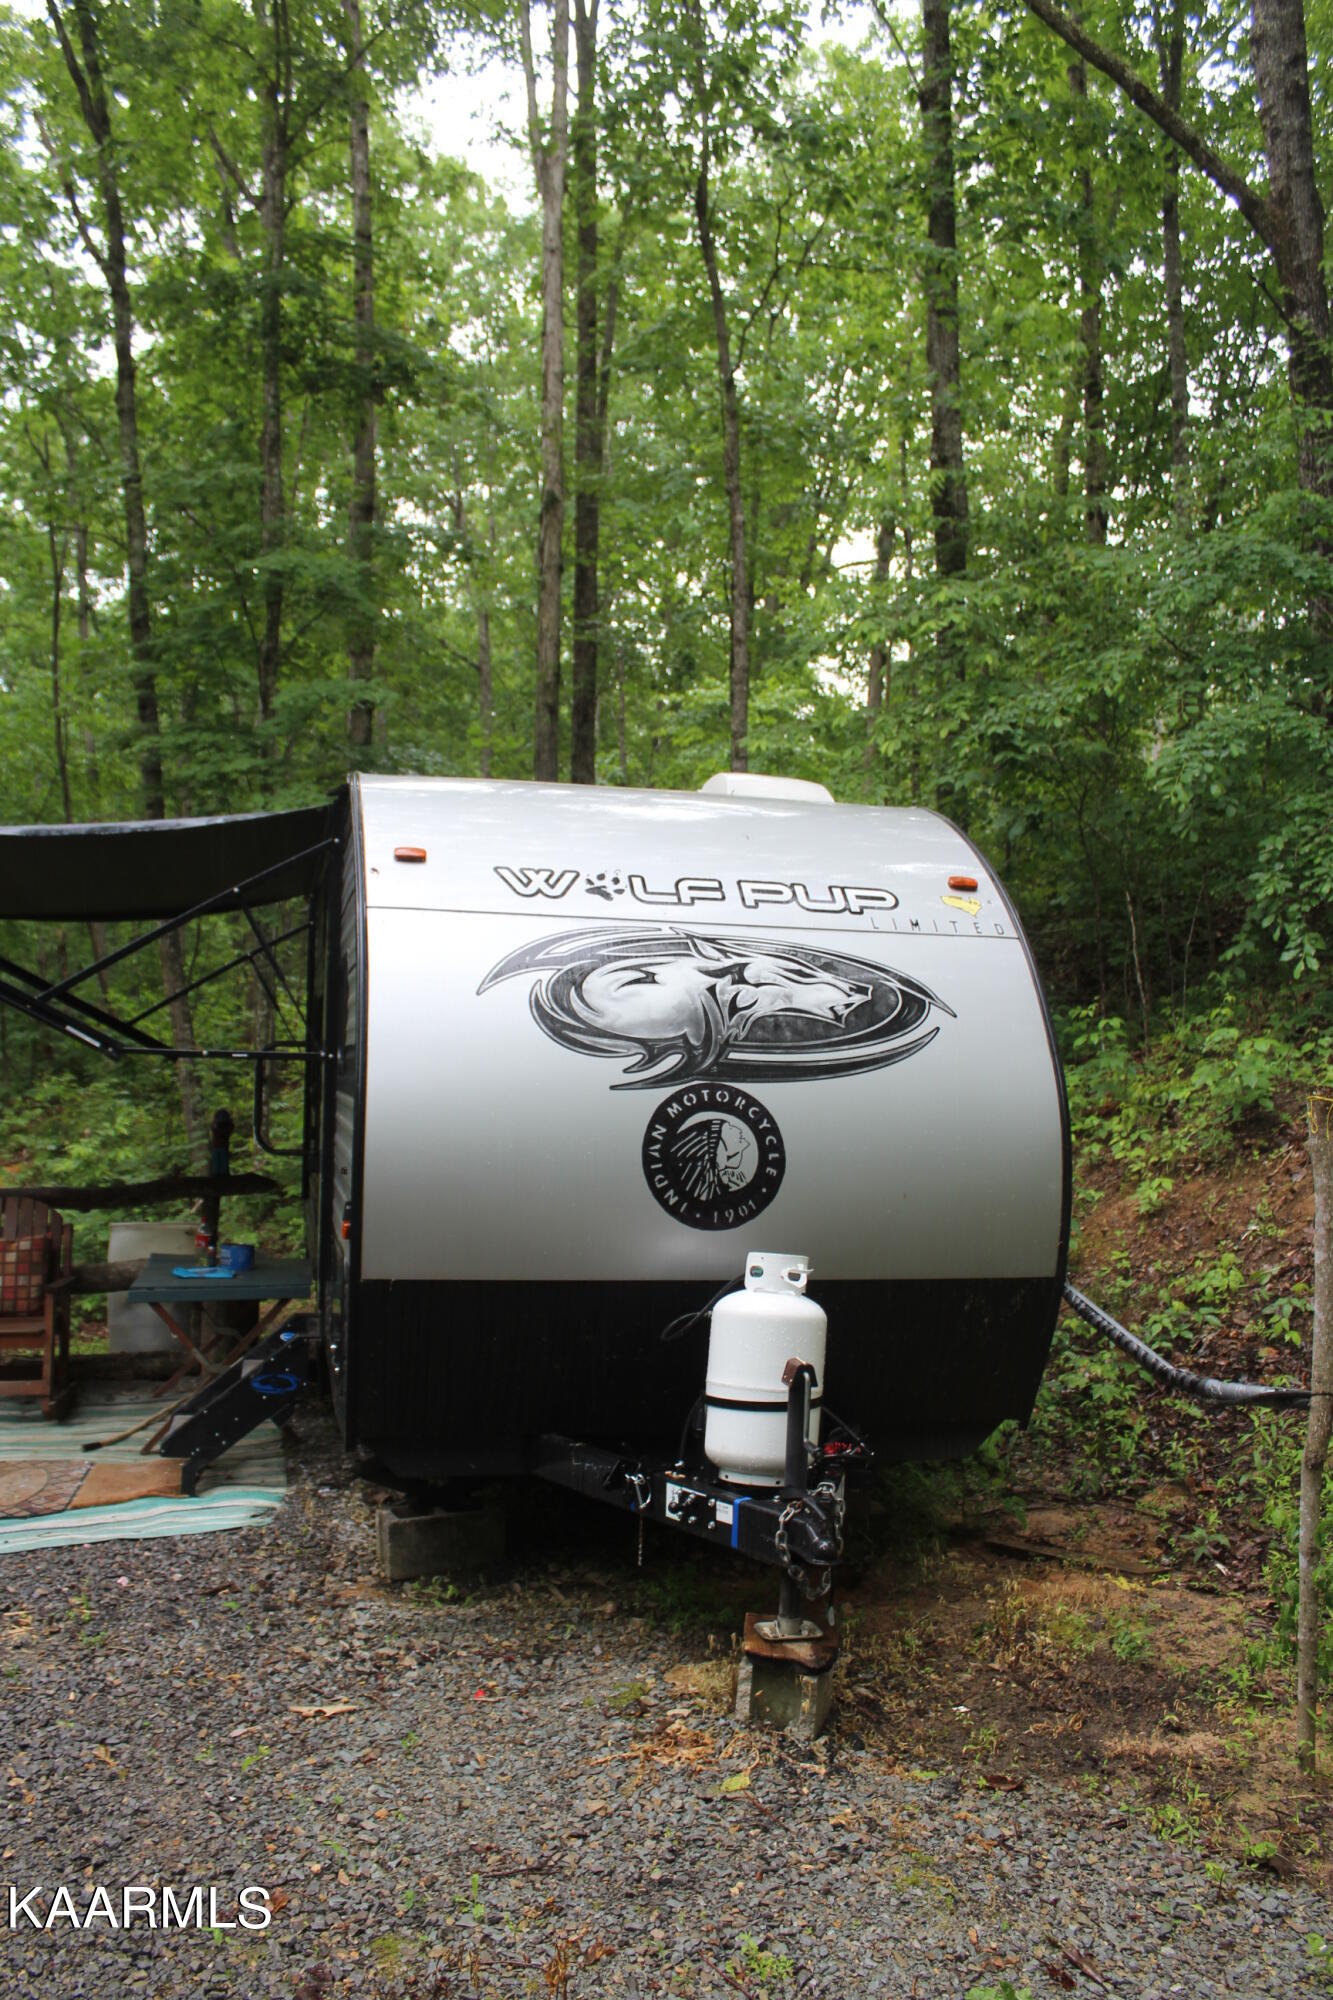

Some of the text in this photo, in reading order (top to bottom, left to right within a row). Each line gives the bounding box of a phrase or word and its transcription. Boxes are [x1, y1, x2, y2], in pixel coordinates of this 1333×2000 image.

[737, 879, 899, 914] PUP
[870, 916, 1005, 936] LIMITED
[648, 1089, 780, 1213] INDIAN MOTORCYCLE
[714, 1199, 757, 1224] 1901
